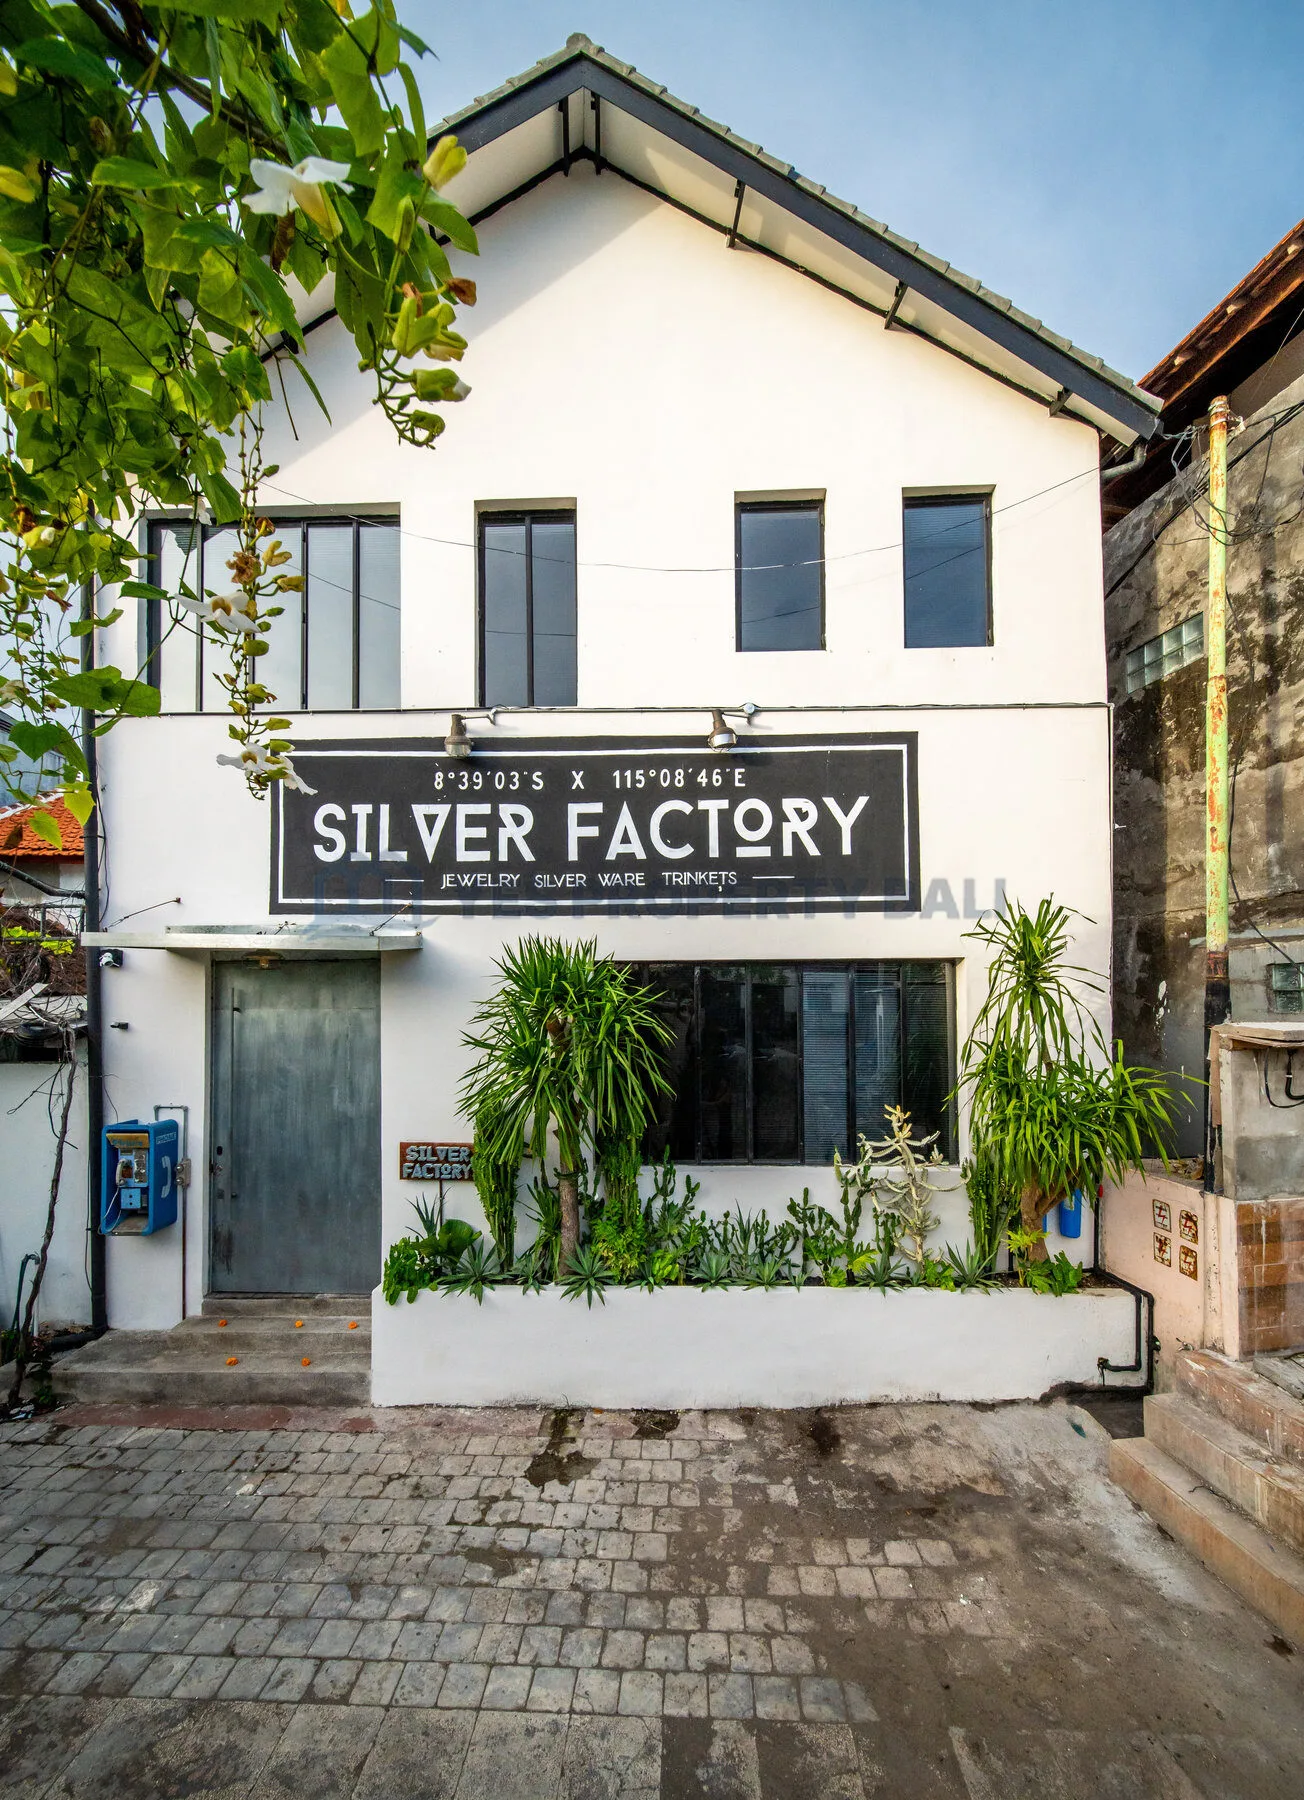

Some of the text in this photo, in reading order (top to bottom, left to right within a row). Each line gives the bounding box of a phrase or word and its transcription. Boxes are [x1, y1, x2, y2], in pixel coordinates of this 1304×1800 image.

[570, 769, 586, 790] X
[313, 795, 870, 864] SILVER FACTORY
[440, 870, 738, 890] JEWELRY SILVER WARE TRINKETS
[402, 1145, 472, 1179] SILVER FACTORY
